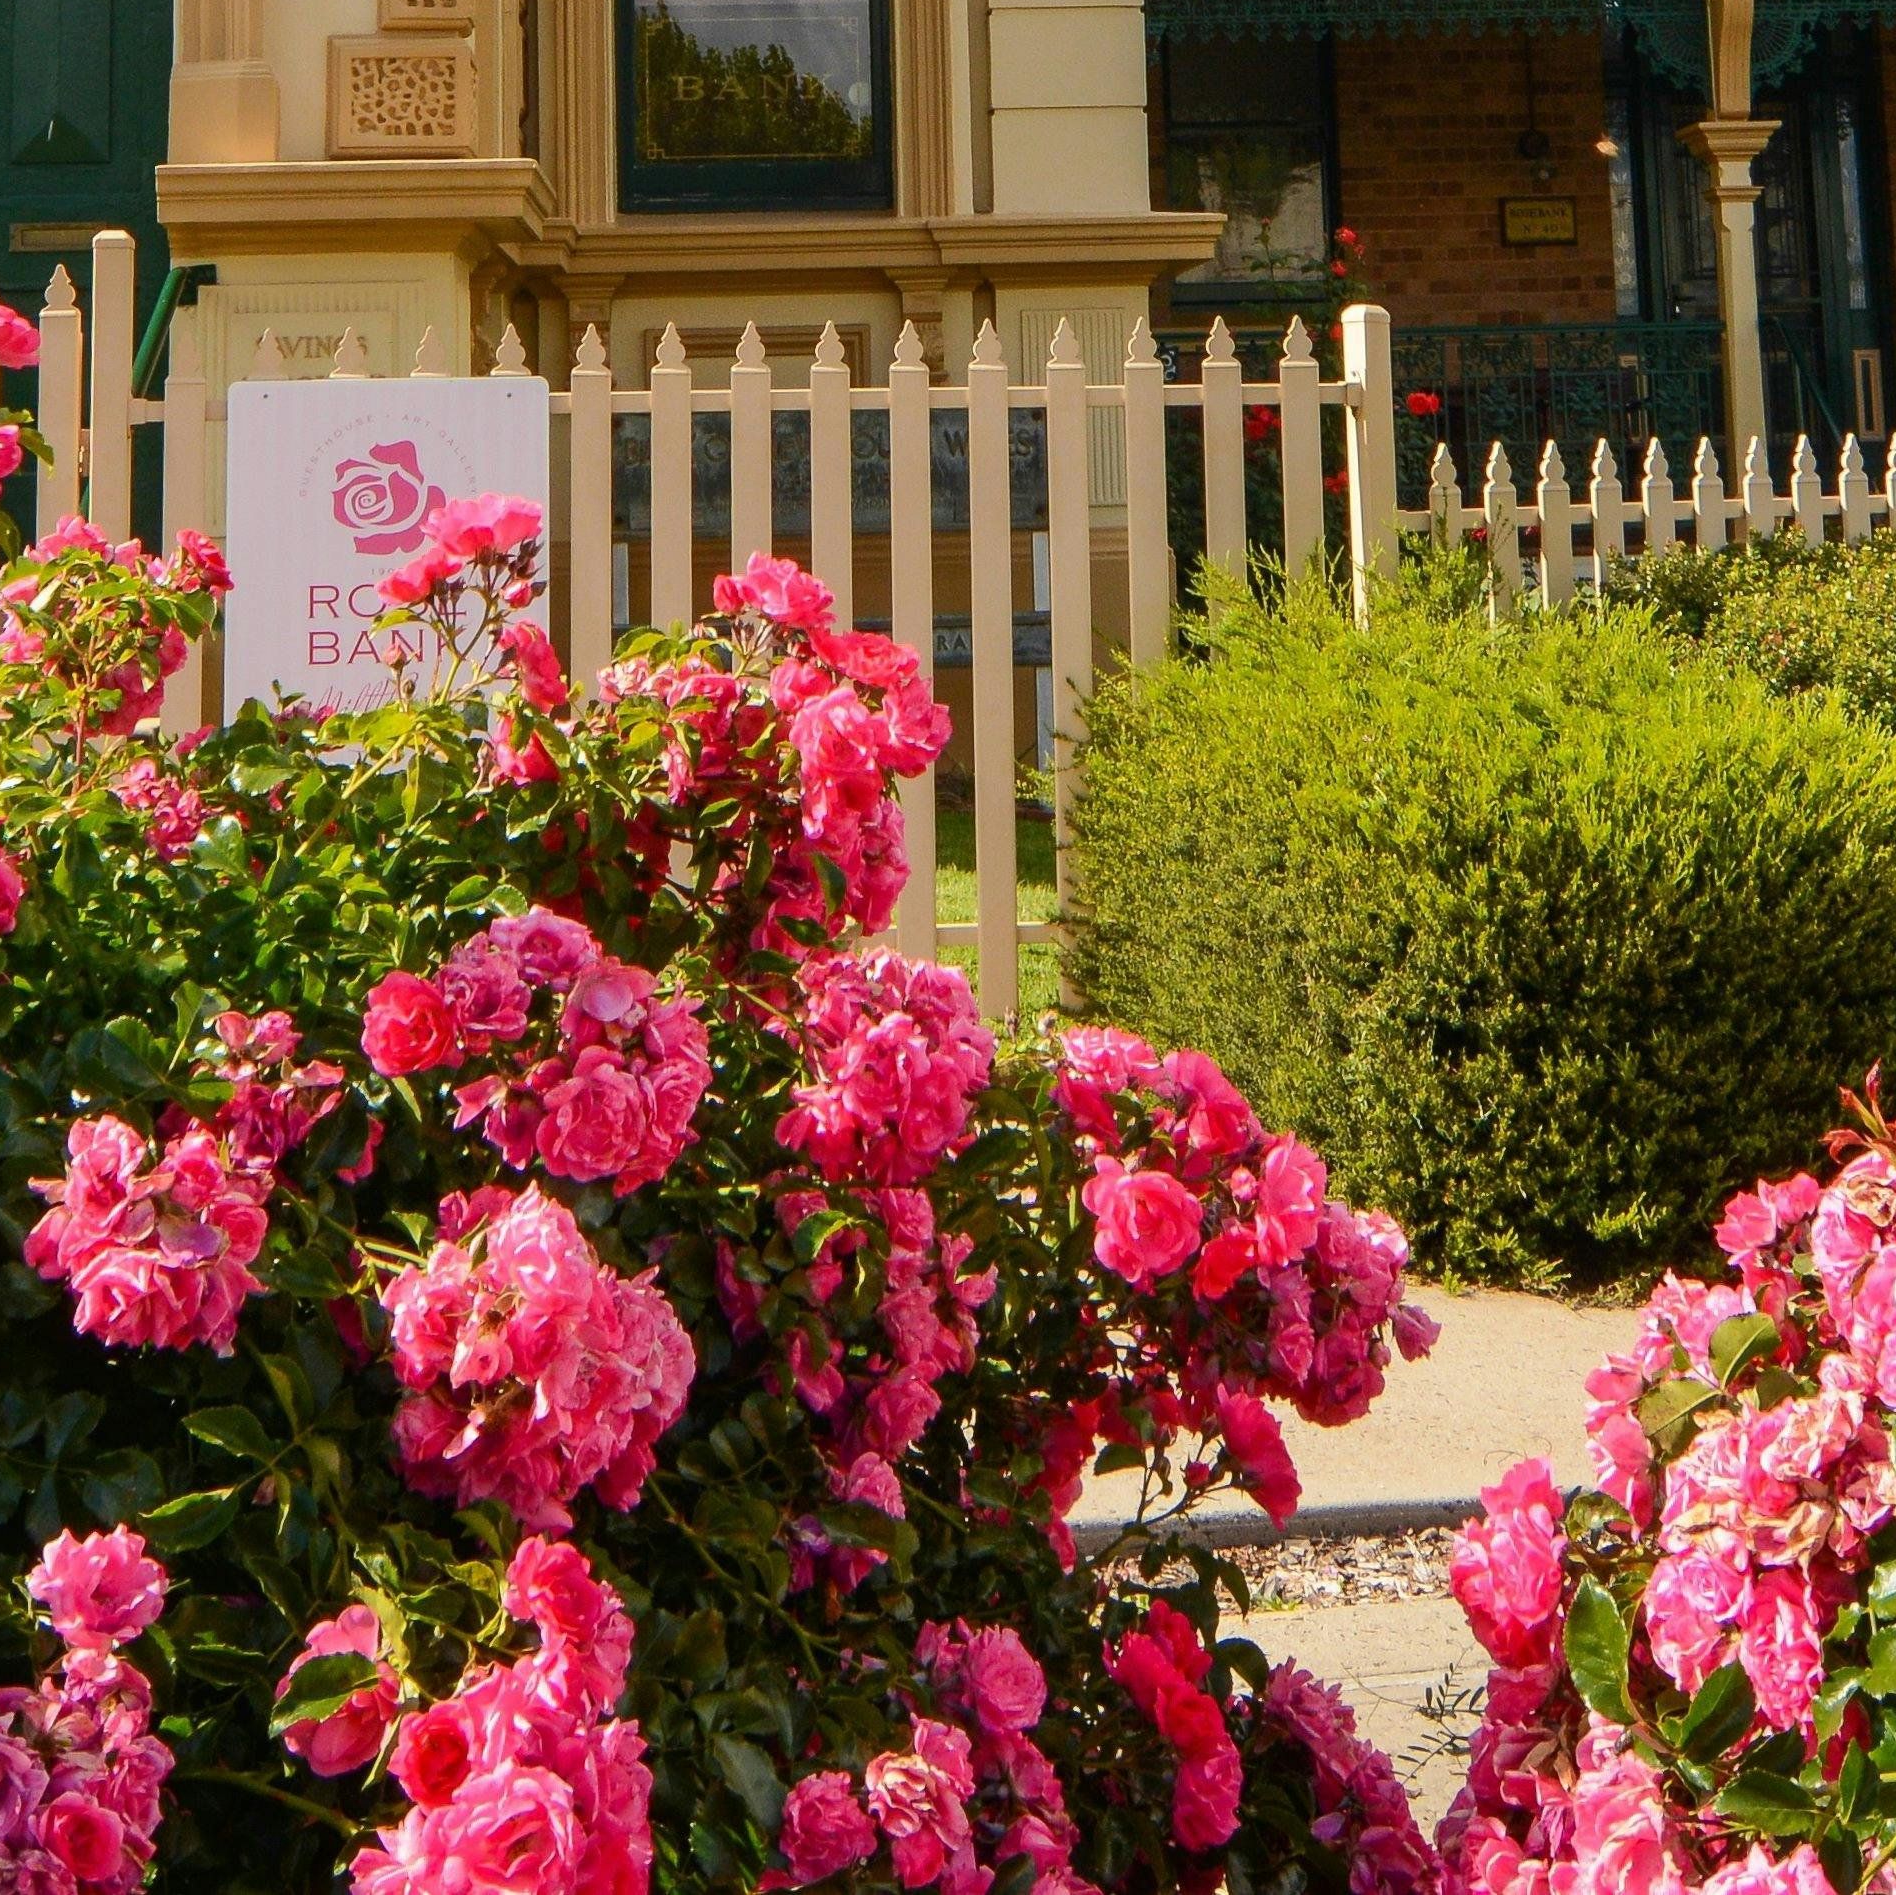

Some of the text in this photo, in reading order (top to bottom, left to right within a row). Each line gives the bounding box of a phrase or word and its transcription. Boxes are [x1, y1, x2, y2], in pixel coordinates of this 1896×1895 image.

[671, 72, 833, 102] BANK
[401, 414, 432, 429] ART
[308, 583, 467, 619] RO
